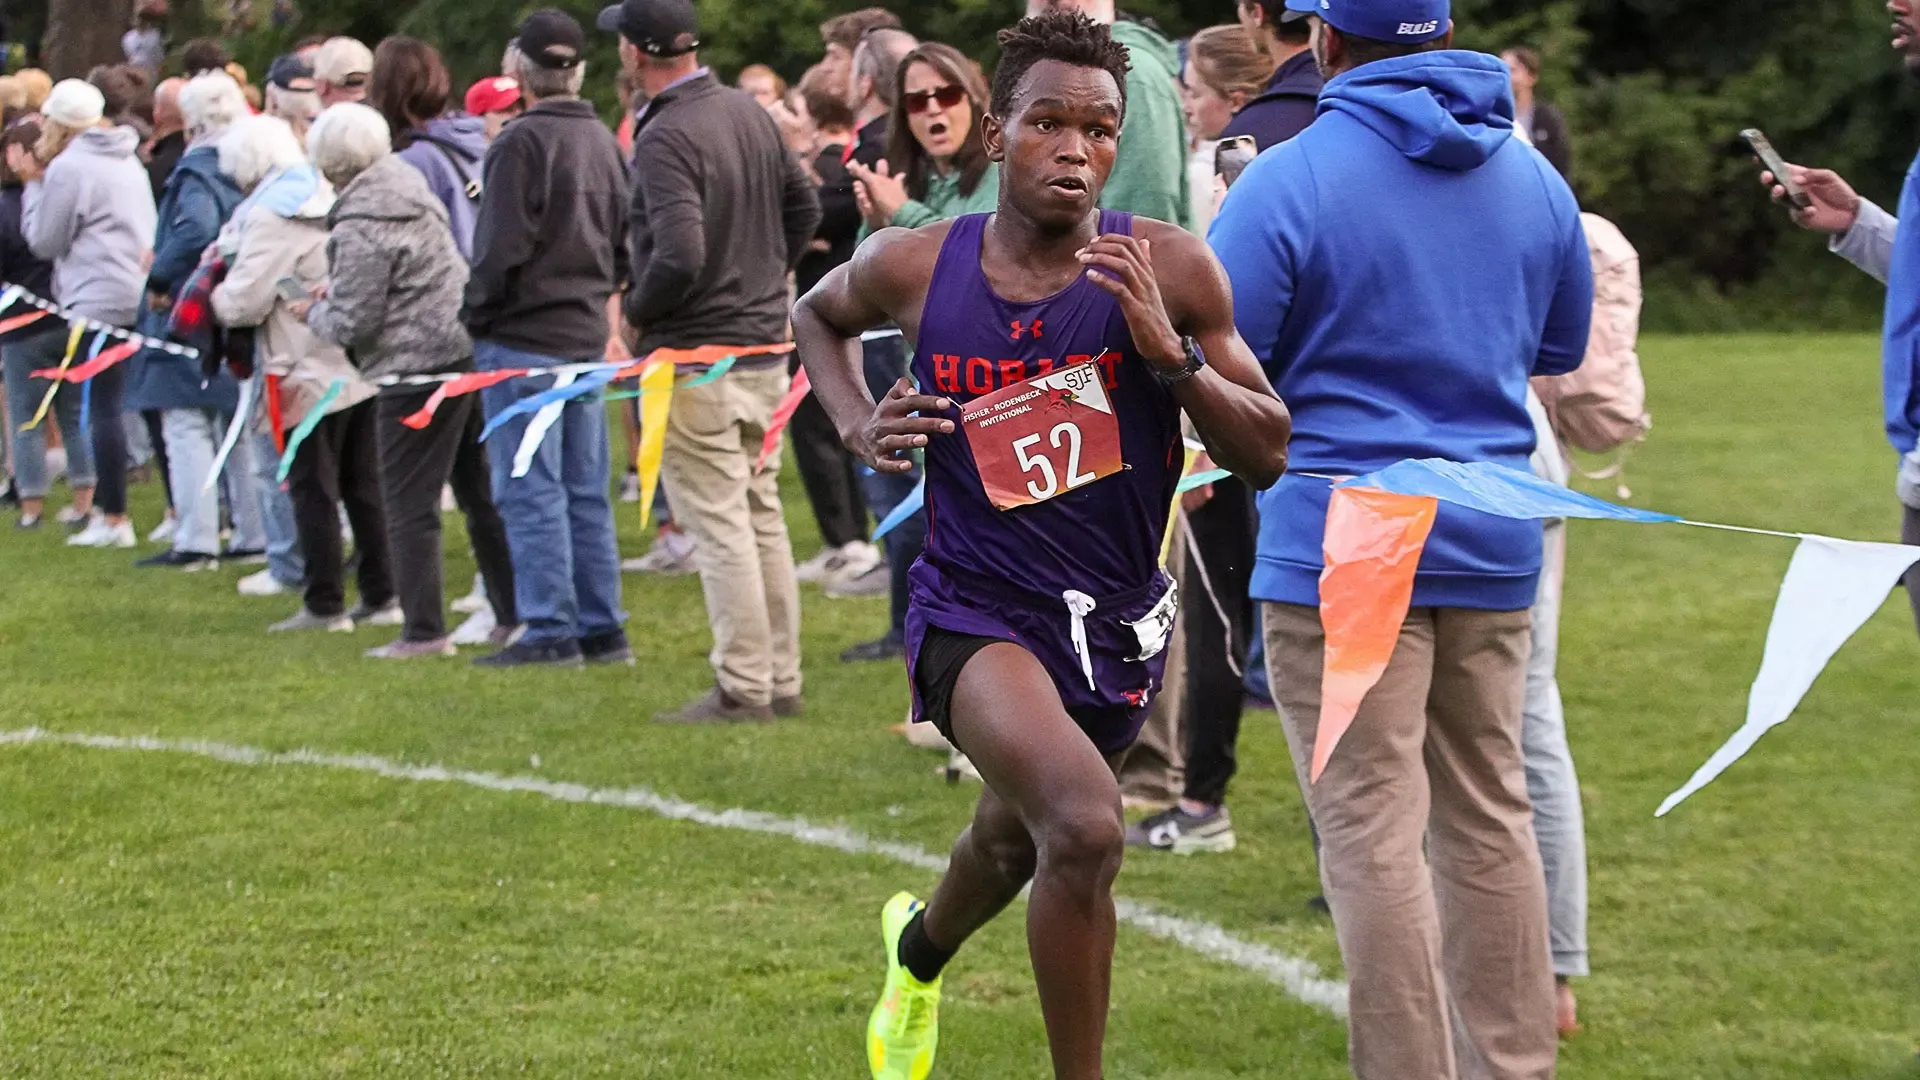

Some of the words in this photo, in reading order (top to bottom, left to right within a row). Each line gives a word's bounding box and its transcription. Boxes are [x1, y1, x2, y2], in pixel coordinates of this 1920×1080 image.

[1396, 20, 1438, 35] BULLS
[932, 353, 1123, 395] HOBT
[1064, 365, 1093, 391] SJF
[963, 407, 990, 423] FISHER
[993, 389, 1042, 412] RODENBECK
[979, 404, 1033, 428] INVITATIONAL
[1012, 421, 1097, 501] 52
